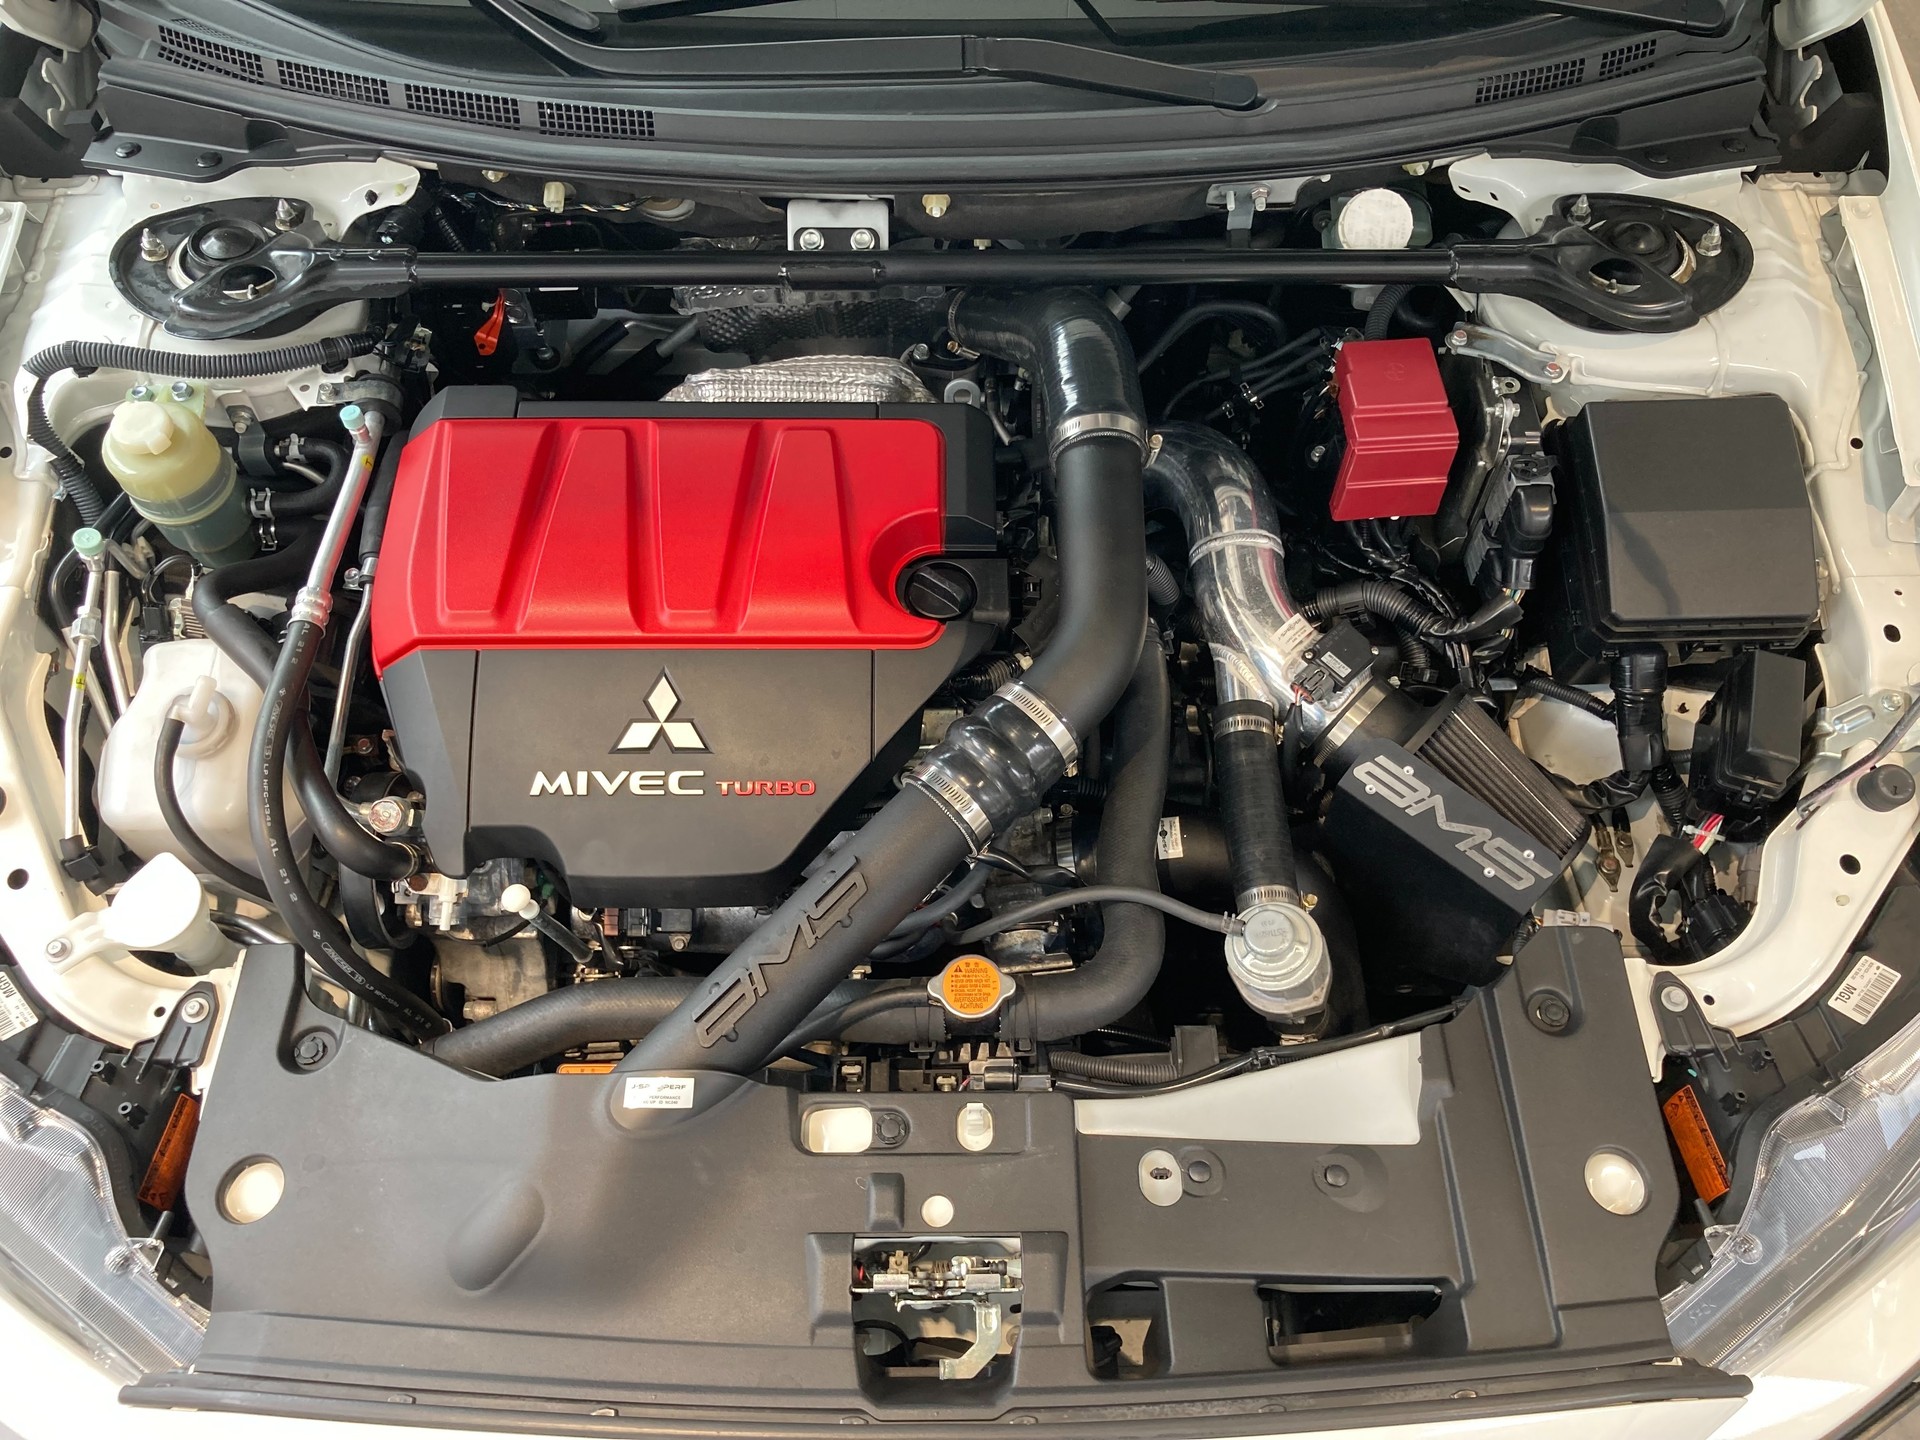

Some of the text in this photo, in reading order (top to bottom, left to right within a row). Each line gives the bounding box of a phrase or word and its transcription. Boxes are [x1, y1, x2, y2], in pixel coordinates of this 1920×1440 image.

[301, 622, 310, 635] AL
[529, 770, 817, 797] MIVEC TURBO
[263, 763, 269, 775] LP
[269, 838, 279, 857] AL
[279, 868, 291, 885] 21
[289, 892, 298, 902] 2
[1834, 983, 1857, 1004] MGL
